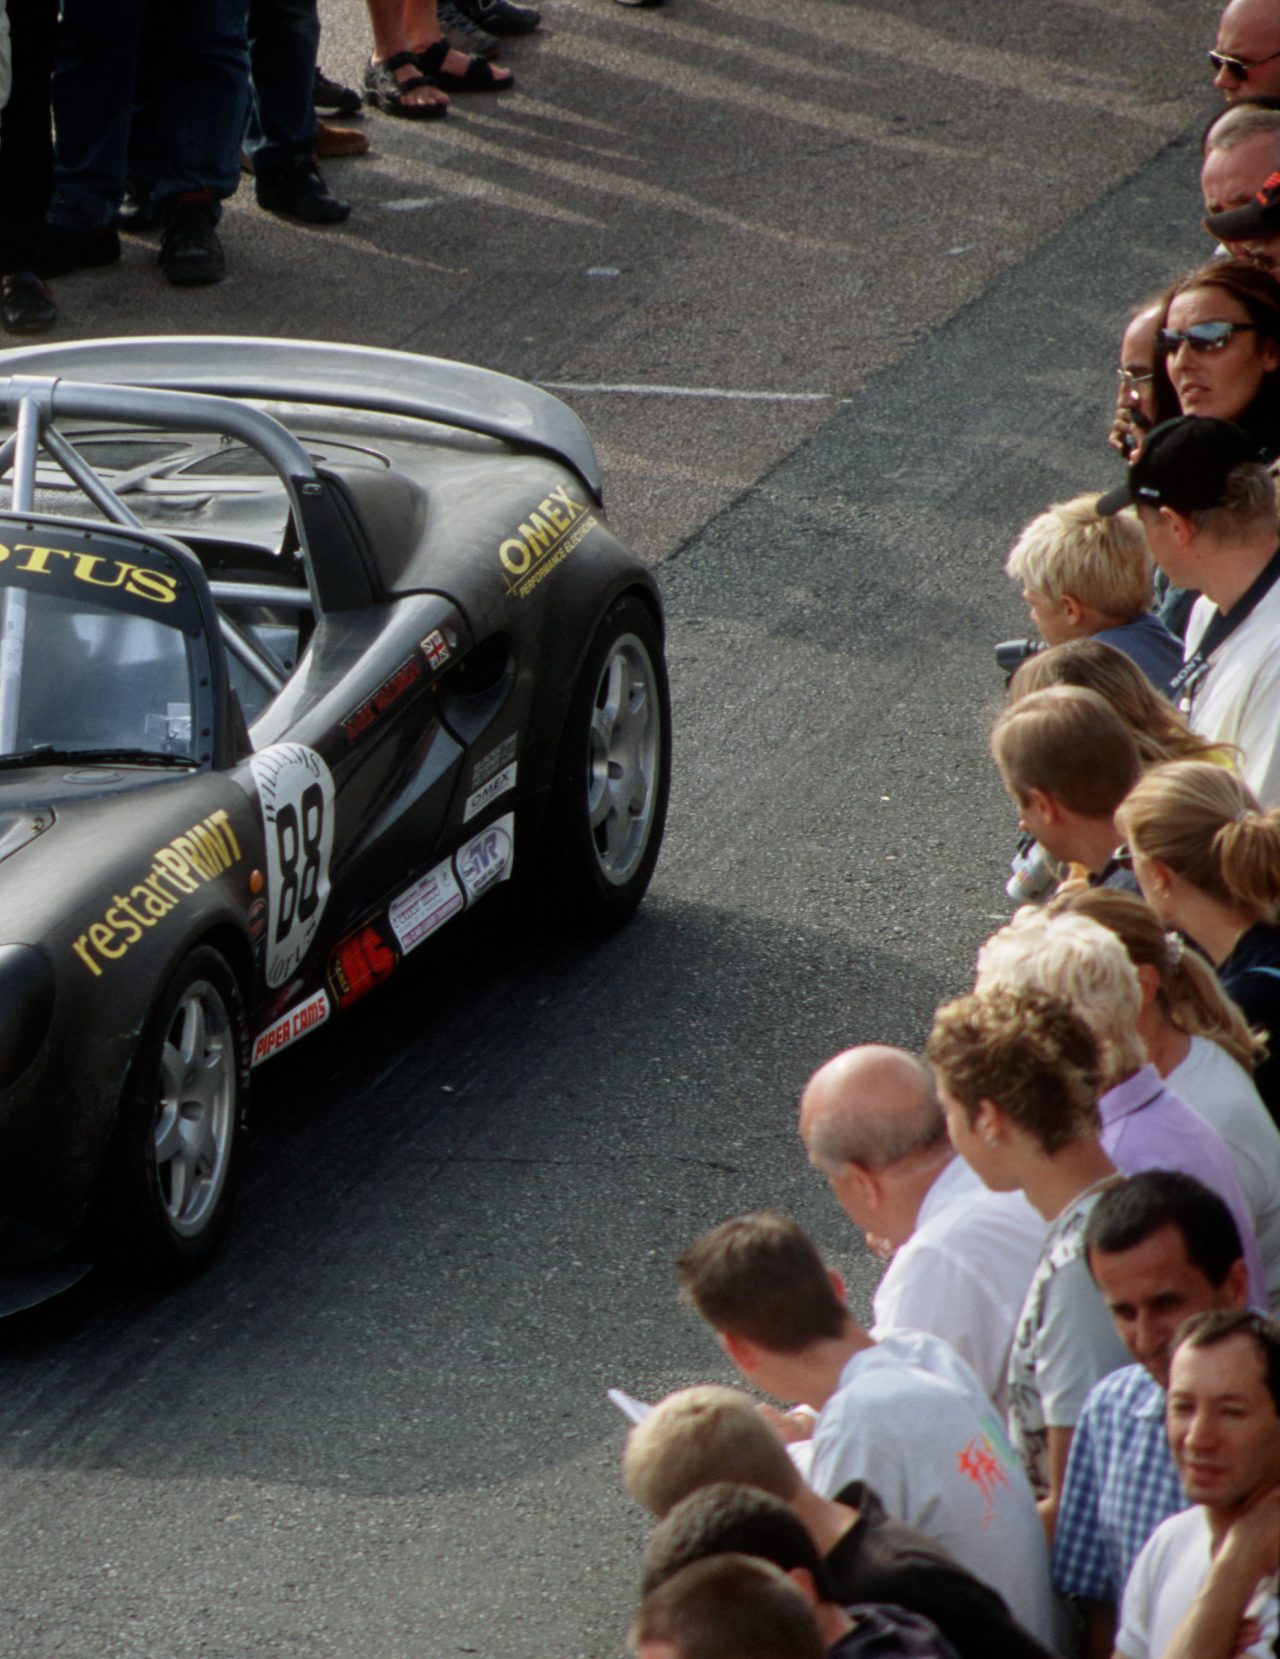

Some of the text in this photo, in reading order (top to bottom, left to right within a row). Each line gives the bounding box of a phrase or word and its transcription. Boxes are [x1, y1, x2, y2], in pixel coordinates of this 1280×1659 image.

[499, 485, 584, 575] OMEX
[1169, 651, 1202, 688] SONY
[471, 770, 511, 807] OMEX
[72, 809, 241, 976] restartPRINT
[275, 782, 324, 944] 88
[254, 996, 326, 1061] PIPER CAMS
